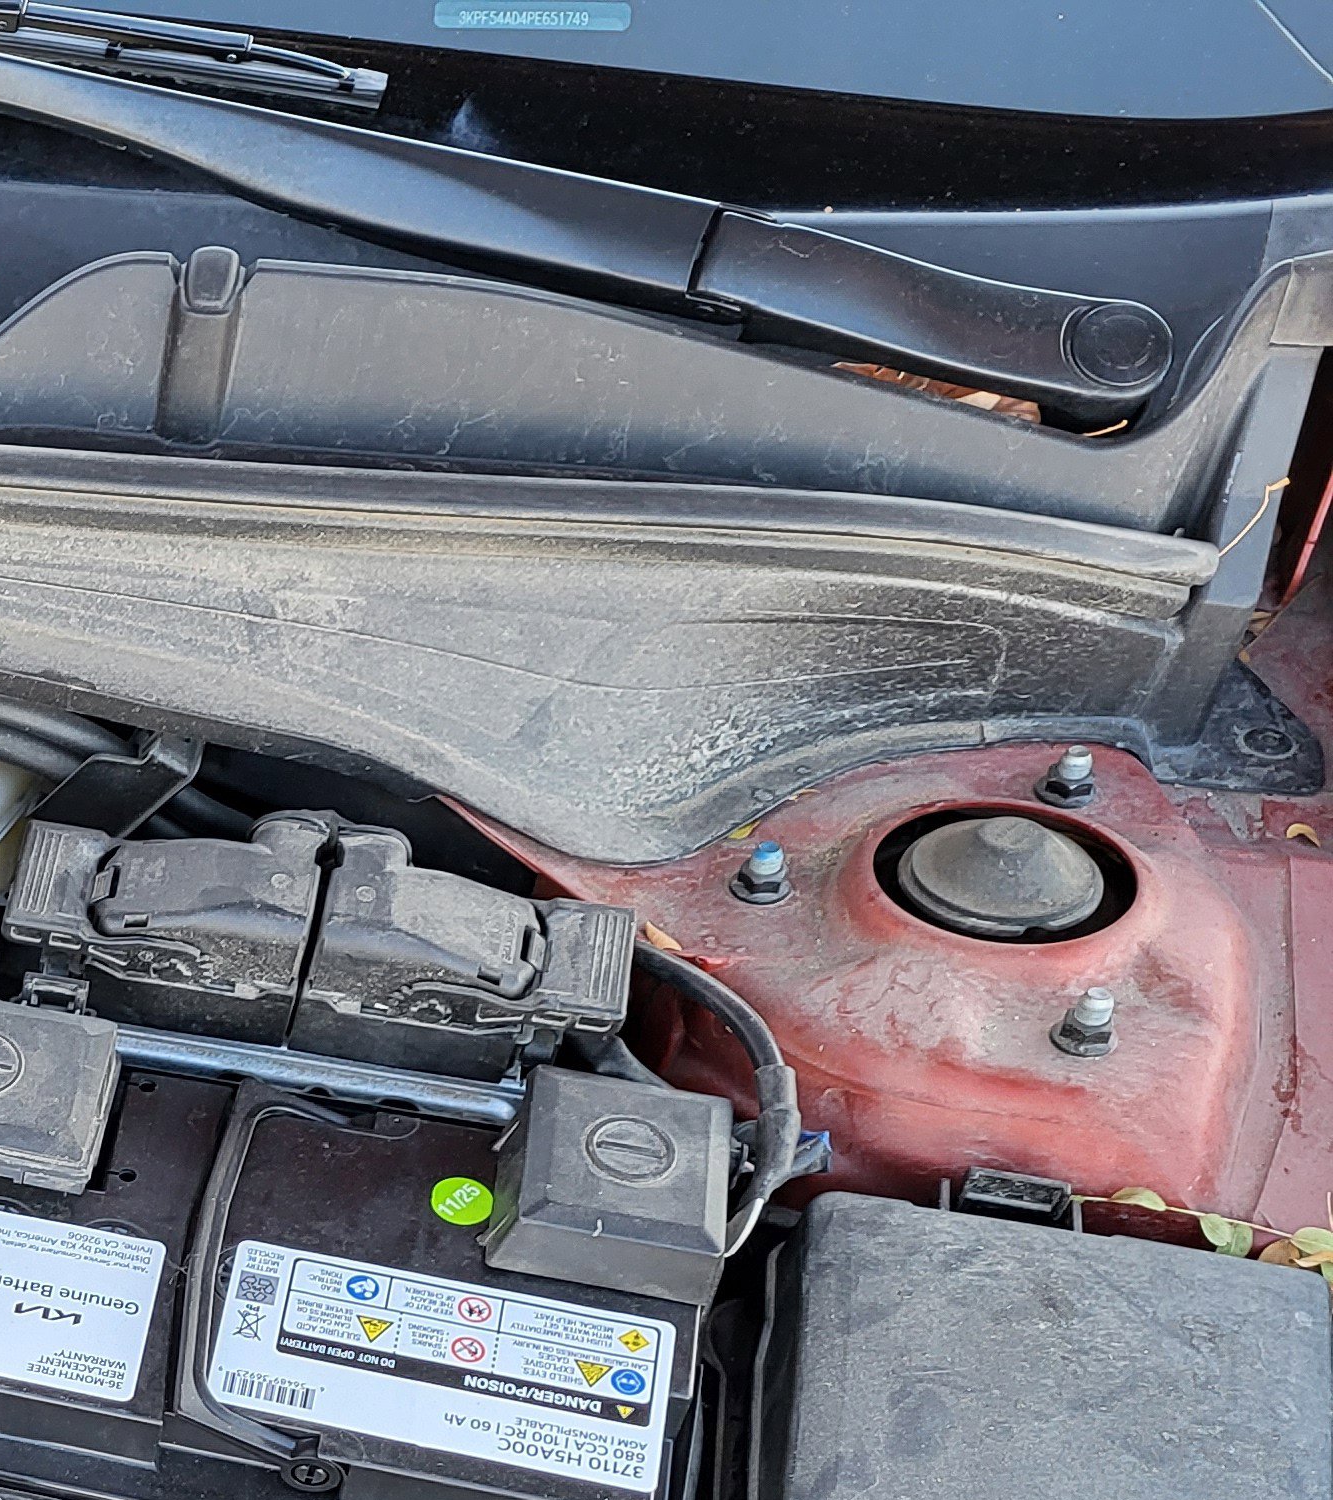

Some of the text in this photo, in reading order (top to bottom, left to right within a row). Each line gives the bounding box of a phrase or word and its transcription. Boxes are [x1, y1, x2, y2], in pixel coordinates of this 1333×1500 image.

[438, 1183, 480, 1215] 11/25
[0, 1238, 26, 1248] details.
[14, 1230, 58, 1246] America,
[67, 1231, 153, 1255] Irvine, CA 92606
[60, 1240, 76, 1250] Kia
[78, 1242, 91, 1253] by
[40, 1247, 81, 1260] Consultant
[93, 1247, 151, 1265] Distributed
[83, 1255, 111, 1266] Service
[112, 1259, 131, 1270] your
[258, 1258, 279, 1267] MUST
[245, 1262, 278, 1274] BATTERY
[307, 1274, 342, 1286] INSTRUC-
[320, 1284, 341, 1293] READ
[59, 1288, 139, 1315] Genuine
[245, 1304, 260, 1312] Pb
[410, 1295, 453, 1309] THE REACH
[415, 1303, 431, 1311] OUT
[309, 1308, 352, 1322] BLINDNESS
[325, 1304, 353, 1315] SEVERE
[433, 1307, 453, 1316] KEEP
[306, 1314, 350, 1329] CAN CAUSE
[543, 1321, 559, 1330] GET
[555, 1317, 577, 1326] HELP
[579, 1321, 614, 1334] MEDICAL
[296, 1321, 361, 1341] SULFURIC ACID
[408, 1323, 444, 1335] SMOKING
[510, 1322, 612, 1348] FLUSH EYES IMMEDIATELY
[591, 1331, 613, 1340] WITH
[411, 1331, 443, 1342] FLAMES
[411, 1338, 442, 1349] SPARKS
[279, 1336, 395, 1368] DO NOT OPEN BATTERY!
[431, 1349, 446, 1359] NO
[538, 1351, 569, 1364] GASES
[555, 1348, 600, 1362] BLINDNESS
[37, 1355, 125, 1380] REPLACEMENT
[603, 1357, 629, 1367] CAUSE
[631, 1362, 649, 1371] CAN
[26, 1362, 123, 1390] 36-MONTH FREE
[235, 1369, 269, 1382] 36923
[549, 1372, 583, 1385] SHIELD
[463, 1374, 602, 1413] DANGER/POISON
[444, 1412, 645, 1463] 680 CCA 100 RC 60 Ah
[515, 1417, 647, 1450] AGM NONSPILLABLE
[588, 1457, 644, 1479] 37110
